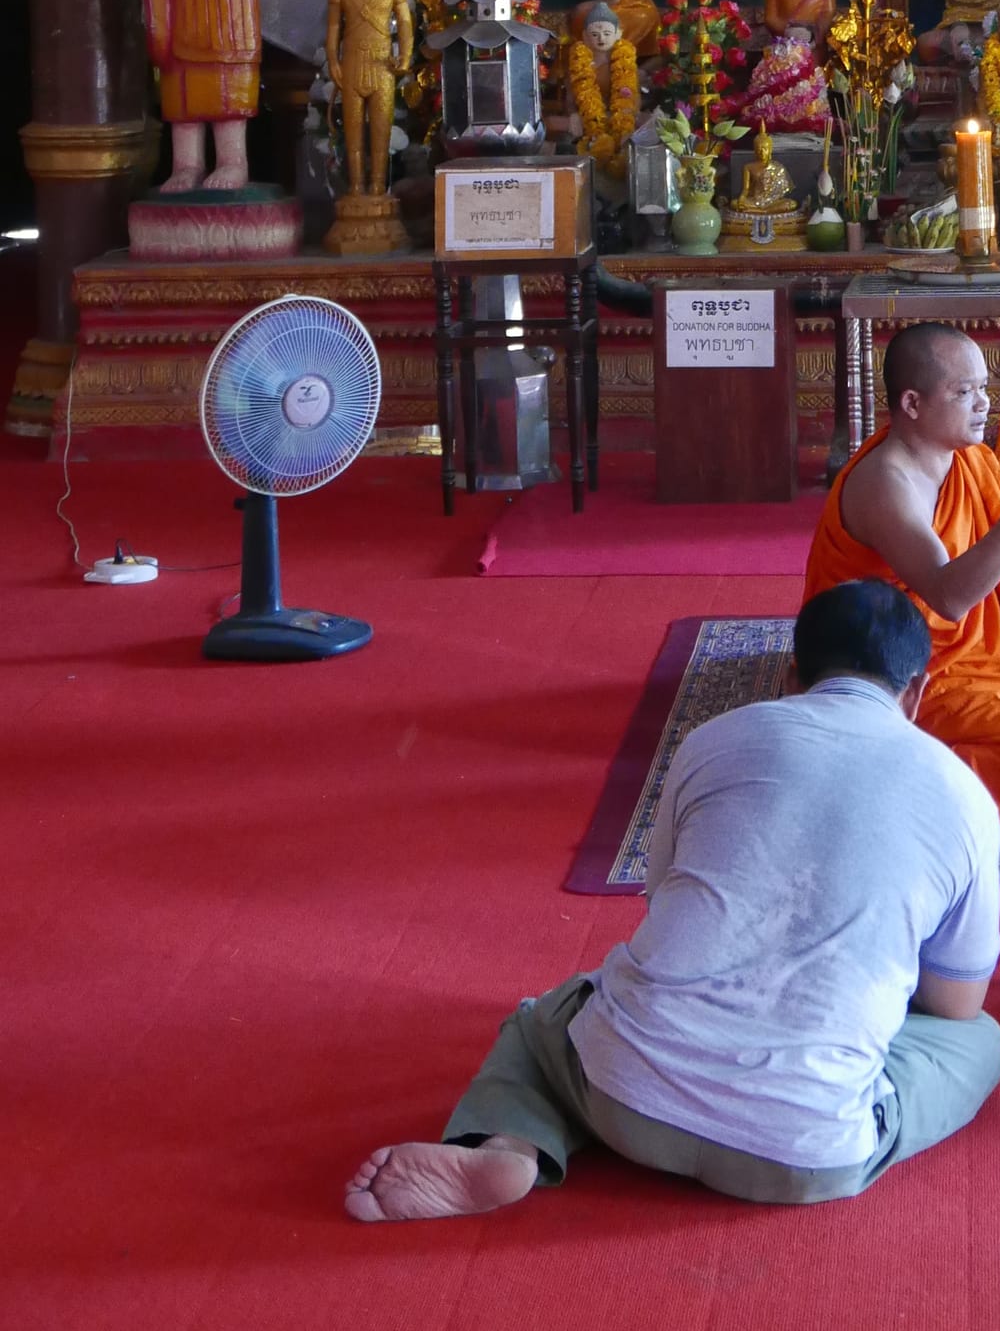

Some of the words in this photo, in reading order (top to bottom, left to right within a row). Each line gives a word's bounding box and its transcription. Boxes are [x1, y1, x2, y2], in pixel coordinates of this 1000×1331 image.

[672, 322, 716, 332] DONATION
[717, 322, 734, 332] FOR
[736, 322, 771, 332] BUDDHA
[684, 337, 754, 361] พุทธบูชา
